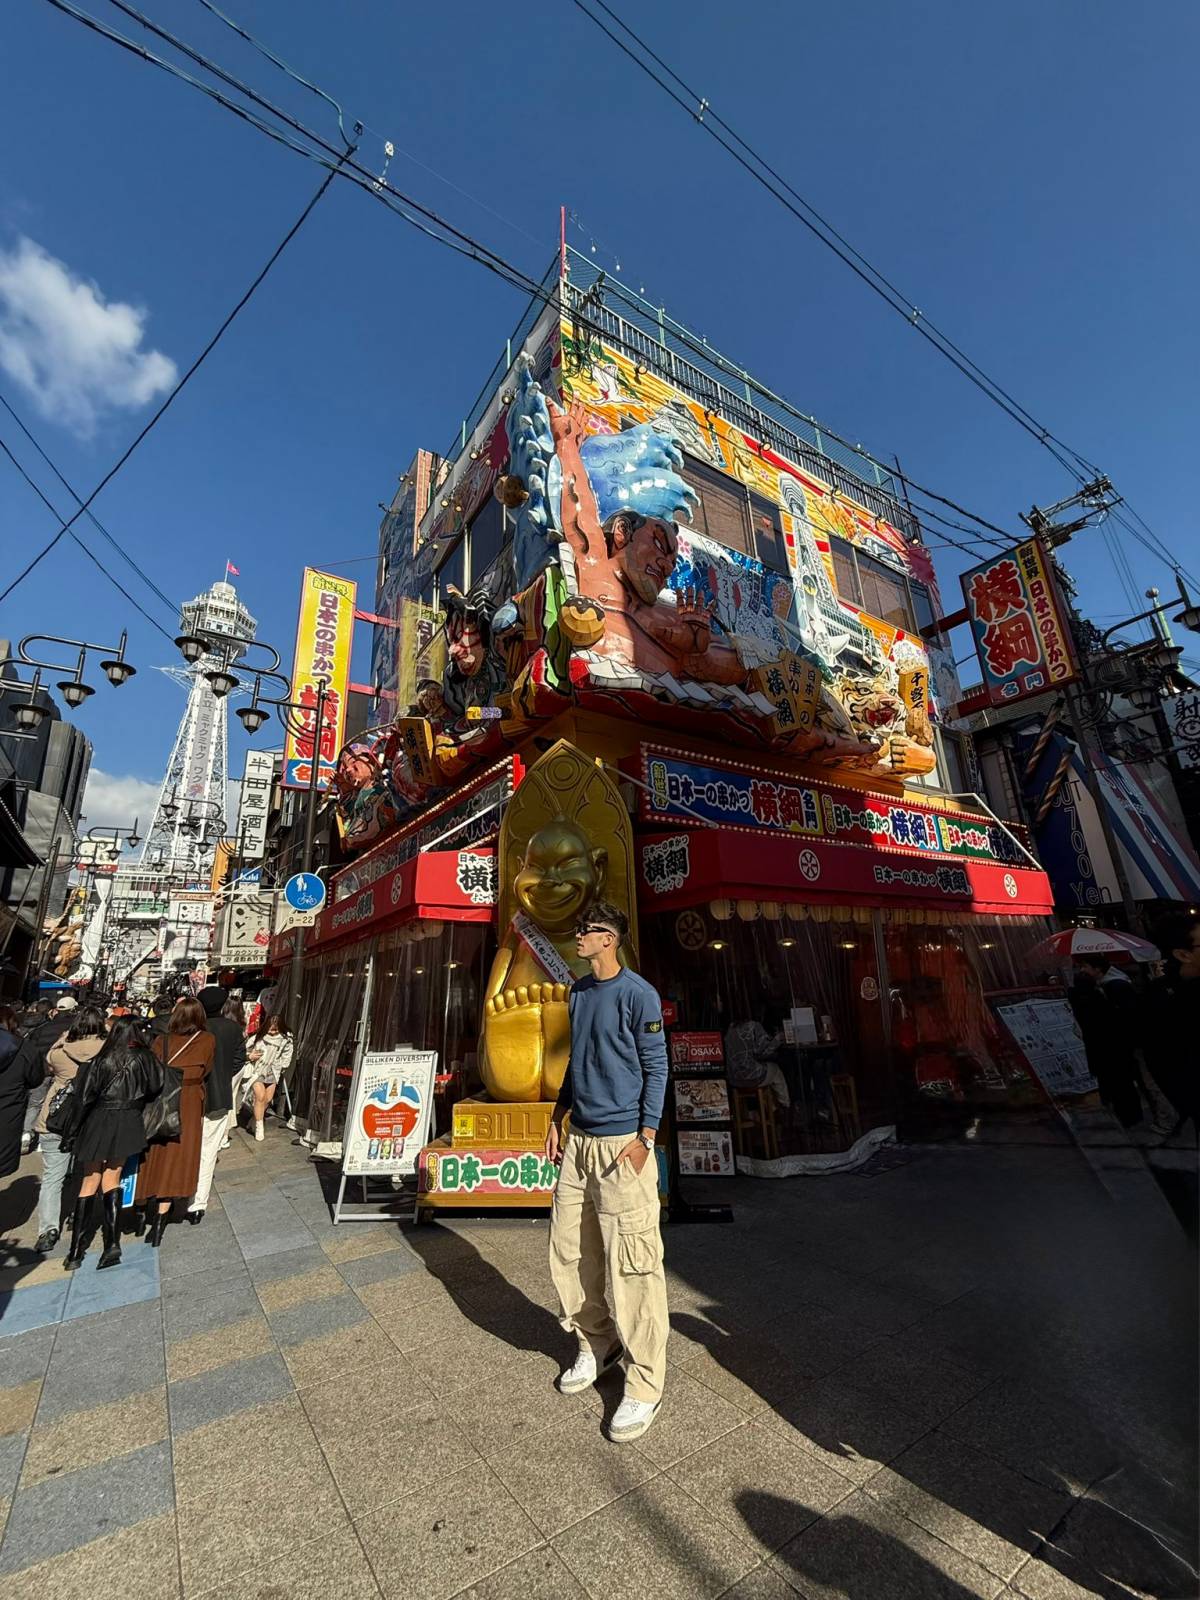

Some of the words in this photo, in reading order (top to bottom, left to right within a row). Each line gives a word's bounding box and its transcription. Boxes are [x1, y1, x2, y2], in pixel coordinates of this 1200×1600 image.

[971, 561, 1039, 676] 横綱
[1030, 581, 1067, 679] 日本一の串かつ
[311, 592, 339, 686] 日本一の串かつ
[766, 668, 794, 727] 横綱
[1002, 672, 1044, 697] 名門
[668, 776, 751, 811] 日本一の串かつ
[751, 781, 804, 827] 横綱
[803, 791, 818, 830] 名門
[835, 804, 890, 832] 日本一の串かつ
[889, 808, 926, 847] 横綱
[644, 836, 688, 857] 日本一の串かつ
[644, 847, 688, 882] 横綱
[874, 866, 938, 886] 日本一の串かつ
[937, 866, 972, 894] 横綱
[1070, 881, 1113, 906] Yen
[288, 915, 313, 925] 9-22
[394, 1054, 432, 1062] DIVERSITY
[690, 1047, 722, 1056] OSAKA
